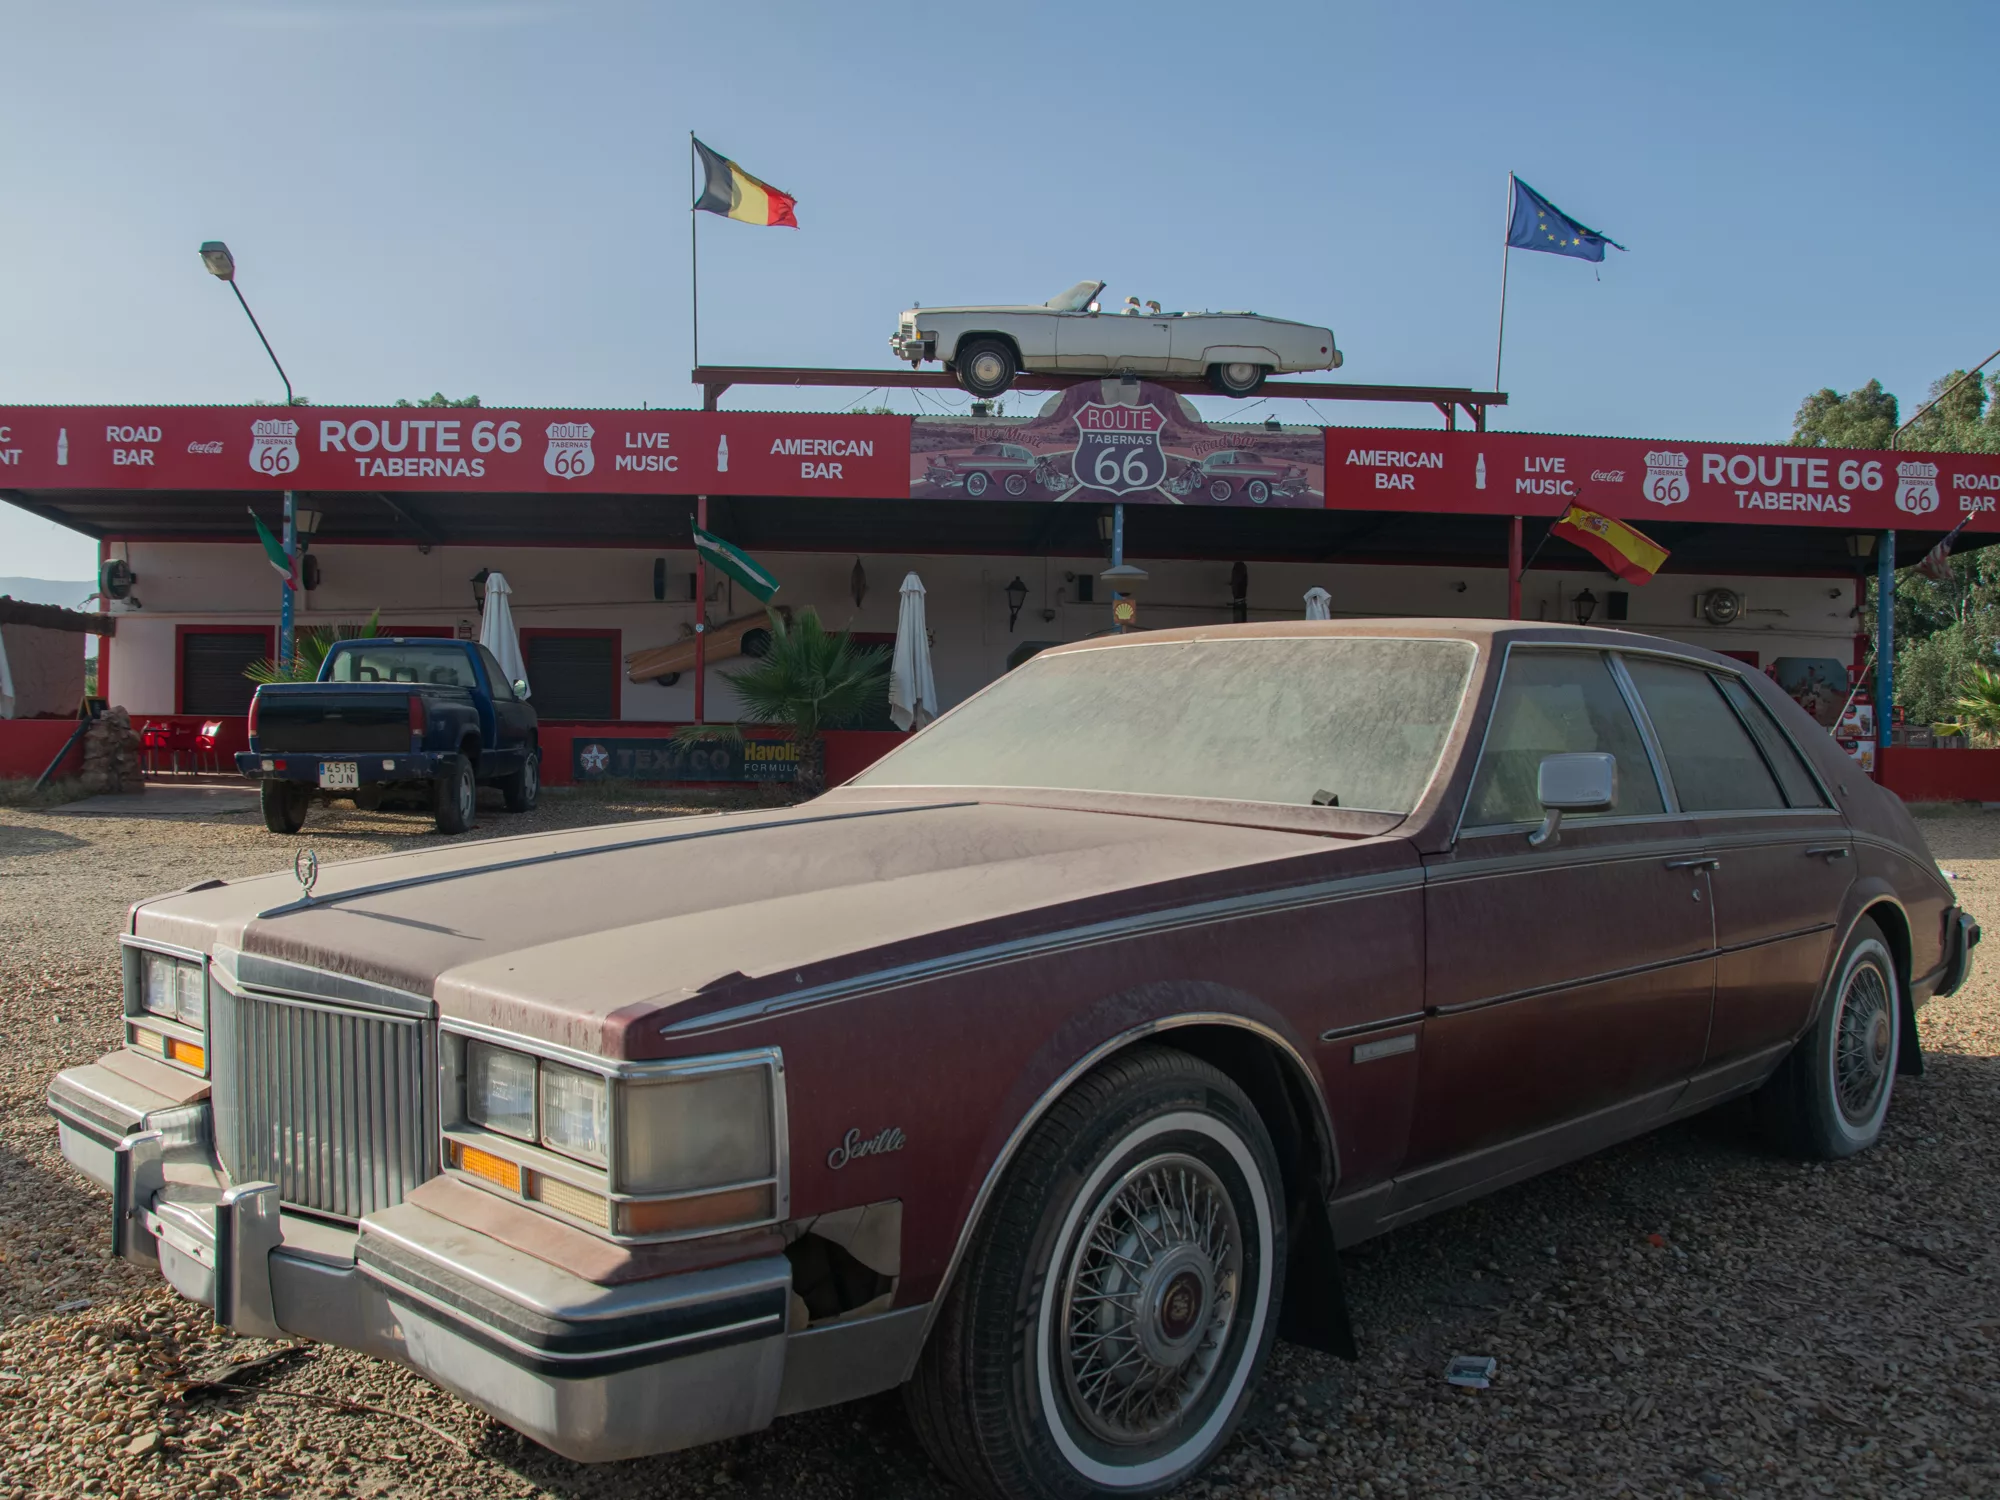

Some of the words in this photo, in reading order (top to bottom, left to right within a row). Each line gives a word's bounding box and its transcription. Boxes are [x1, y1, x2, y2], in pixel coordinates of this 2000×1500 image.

[1088, 409, 1152, 430] ROUTE
[106, 425, 162, 443] ROAD
[256, 422, 294, 435] ROUTE
[319, 420, 461, 453] ROUTE
[471, 420, 522, 453] 66
[551, 425, 589, 438] ROUTE
[256, 438, 293, 446] TABERNAS
[551, 441, 589, 449] TABERNAS
[625, 432, 670, 449] LIVE
[770, 438, 874, 457] AMERICAN
[1087, 434, 1153, 445] TABERNAS
[113, 449, 155, 466] BAR
[260, 447, 291, 472] 66
[554, 450, 586, 475] 66
[615, 455, 679, 472] MUSIC
[1094, 446, 1149, 486] 66
[1346, 449, 1443, 469] AMERICAN
[1524, 456, 1566, 473] LIVE
[1650, 453, 1684, 467] ROUTE
[355, 457, 486, 477] TABERNAS
[801, 462, 844, 479] BAR
[1649, 469, 1684, 477] TABERNAS
[1702, 453, 1829, 489] ROUTE
[1838, 459, 1883, 492] 66
[1901, 463, 1935, 477] ROUTE
[1374, 473, 1415, 490] BAR
[1653, 477, 1681, 502] 66
[1901, 479, 1934, 487] TABERNAS
[1953, 473, 2000, 490] ROAD
[1734, 490, 1852, 513] TABERNAS
[1905, 487, 1931, 511] 66
[1959, 495, 1996, 512] BAR
[327, 763, 356, 774] 4516
[744, 763, 799, 772] FORMULA
[328, 773, 354, 784] CJN
[827, 1127, 907, 1170] Seville
